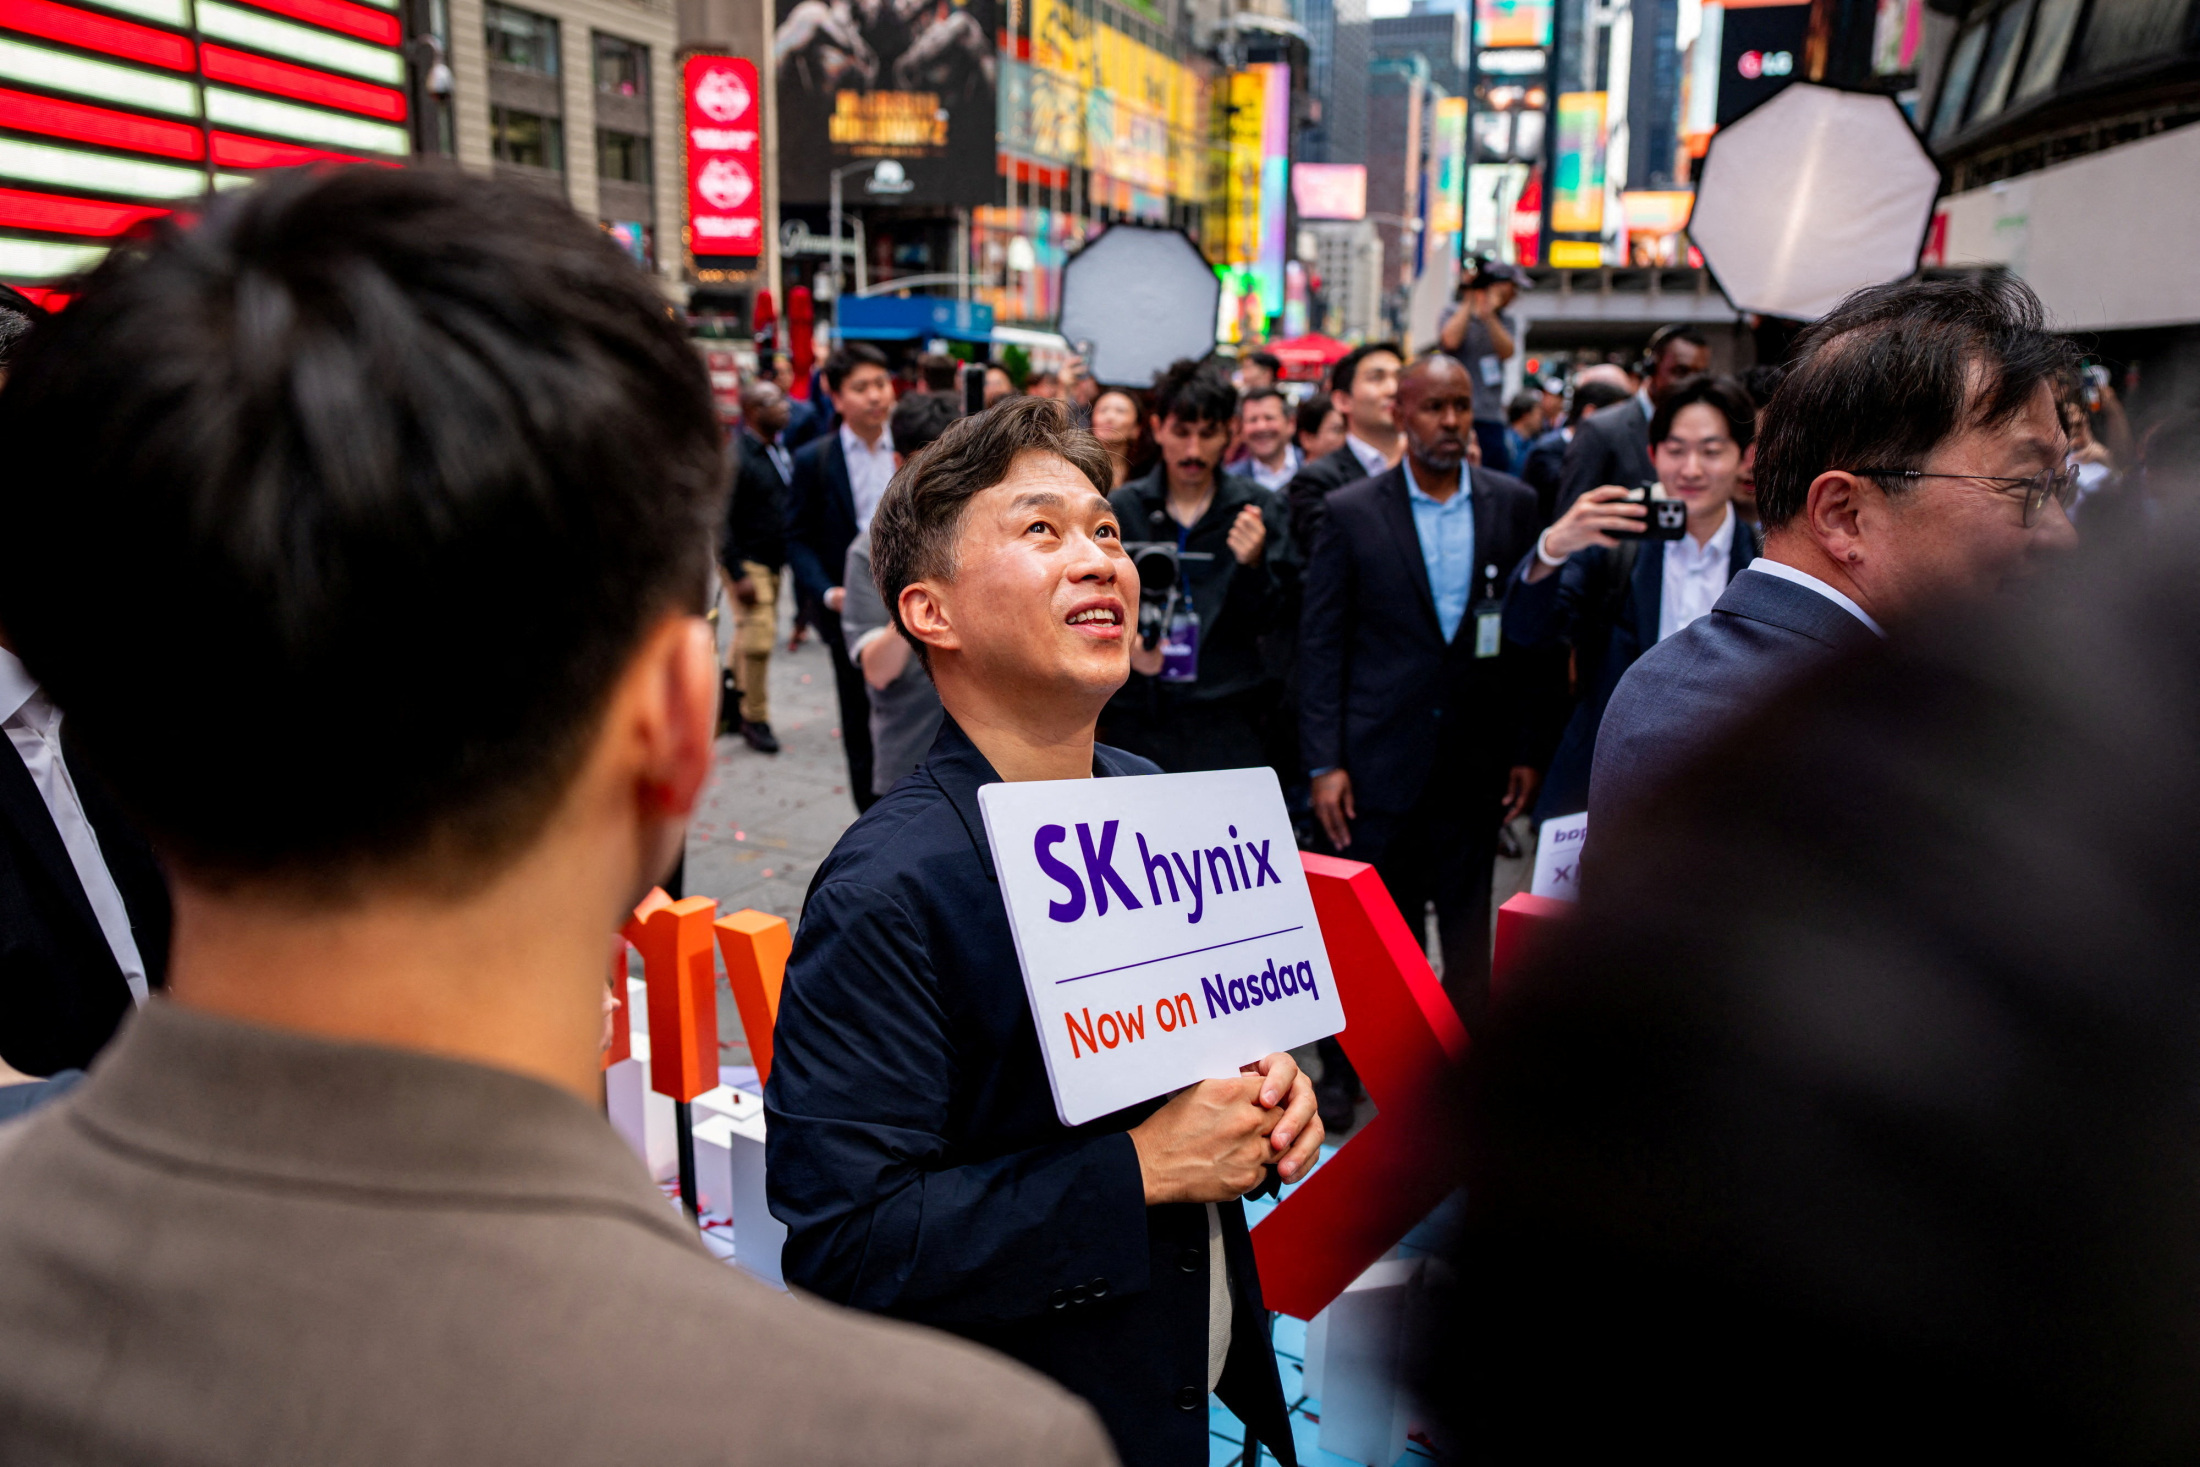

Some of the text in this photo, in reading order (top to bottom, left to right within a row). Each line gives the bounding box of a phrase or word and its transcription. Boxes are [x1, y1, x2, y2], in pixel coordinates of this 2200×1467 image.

[1762, 51, 1793, 76] LG
[1033, 820, 1282, 925] SK hynix
[1064, 959, 1320, 1059] Now on Nasdaq
